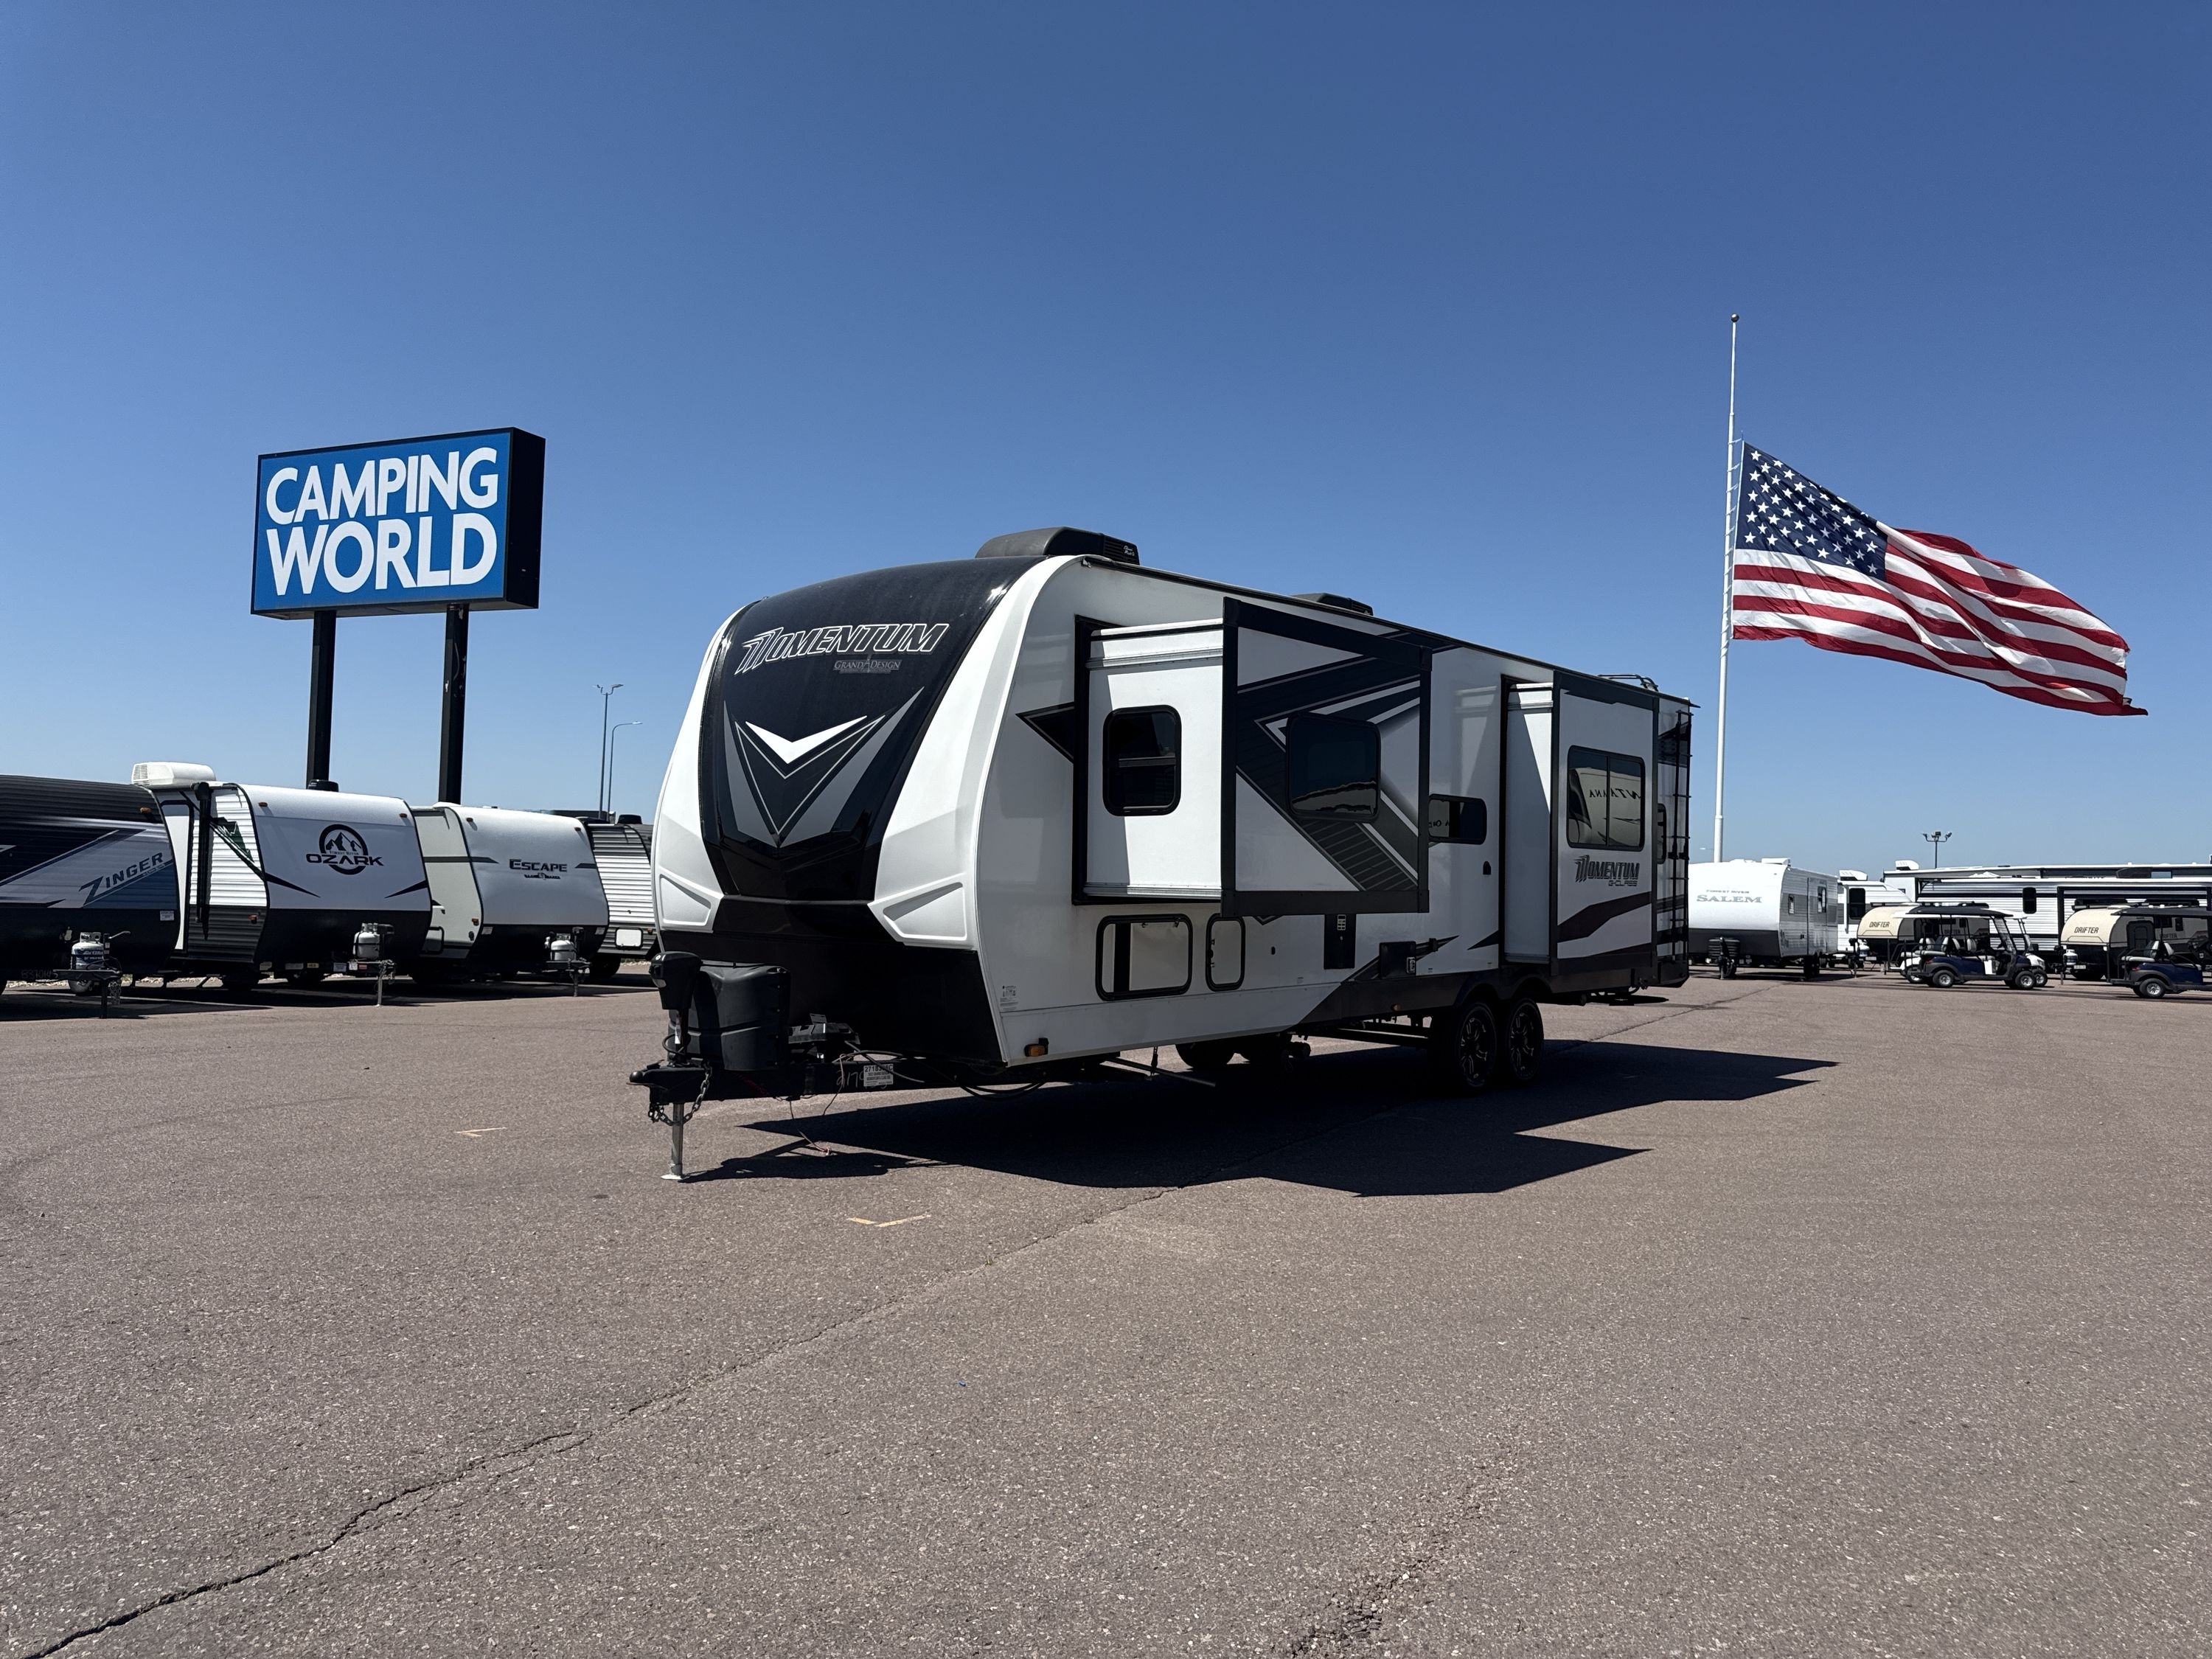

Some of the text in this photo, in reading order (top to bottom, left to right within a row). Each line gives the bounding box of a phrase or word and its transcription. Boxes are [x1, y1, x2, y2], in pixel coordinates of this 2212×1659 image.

[266, 447, 498, 525] CAMPING
[266, 512, 497, 596] WORLD
[734, 624, 949, 675] MOMENTUM
[834, 660, 900, 669] GRAND DESIGN
[78, 852, 164, 905] ZINGER
[306, 853, 384, 866] OZARK
[1573, 855, 1640, 883] MOMENTUM
[1697, 894, 1762, 903] SALEM
